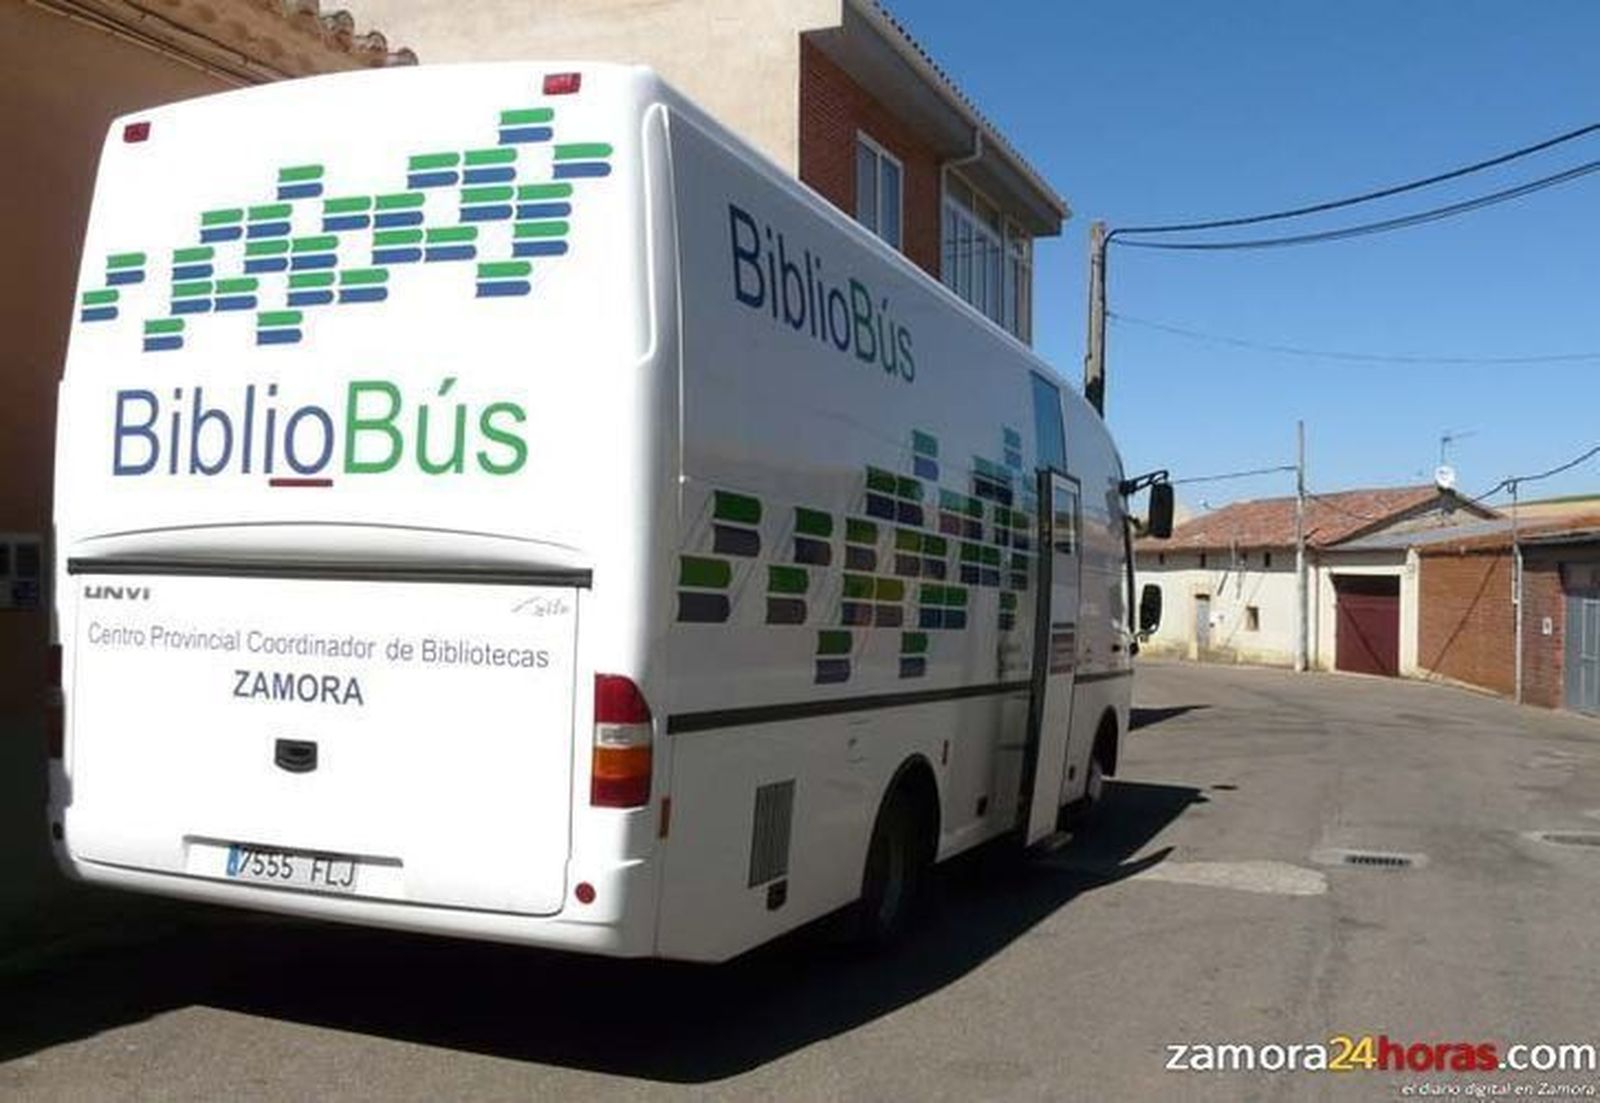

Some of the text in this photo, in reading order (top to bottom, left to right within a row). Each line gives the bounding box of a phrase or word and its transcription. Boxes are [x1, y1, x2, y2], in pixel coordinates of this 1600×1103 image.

[729, 203, 916, 384] BiblioBús
[112, 377, 529, 477] BiblioBús
[88, 621, 550, 668] Centro Provincial Coordinador de Bibliotecas
[233, 669, 365, 706] ZAMORA
[238, 847, 356, 887] 7555 FLJ
